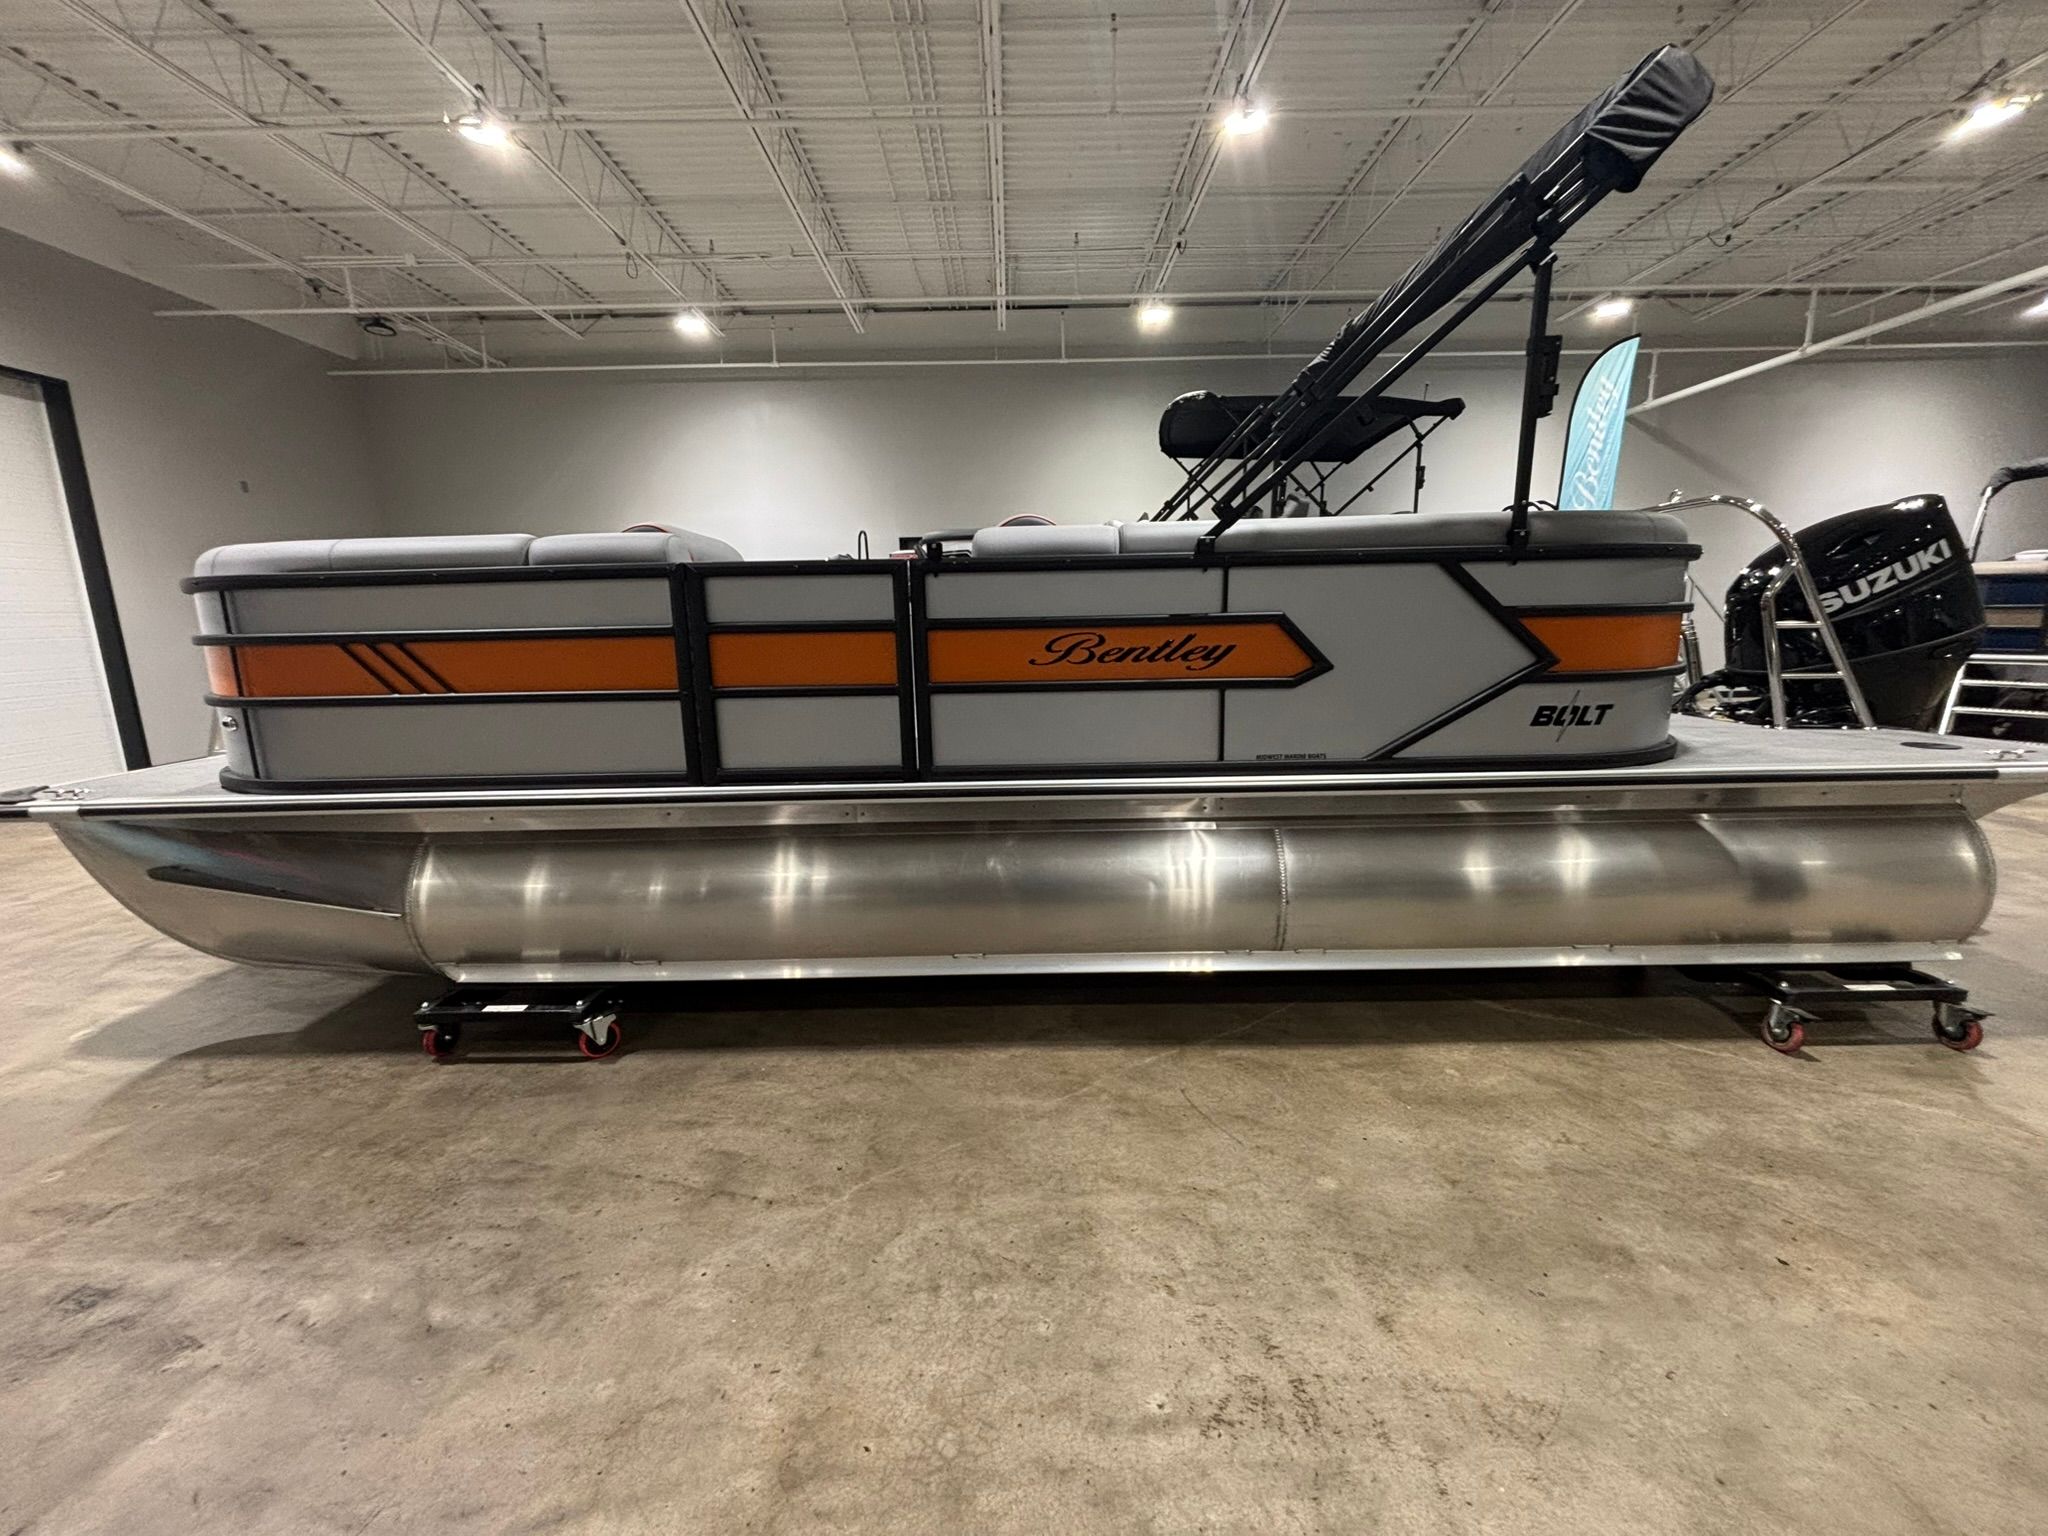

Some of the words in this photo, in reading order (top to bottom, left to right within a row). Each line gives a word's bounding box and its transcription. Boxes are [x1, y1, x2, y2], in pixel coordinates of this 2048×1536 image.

[1572, 375, 1619, 509] Bentley
[1819, 538, 1952, 614] SUZUKI
[1028, 632, 1237, 671] Bentley
[1529, 702, 1615, 730] BOLT
